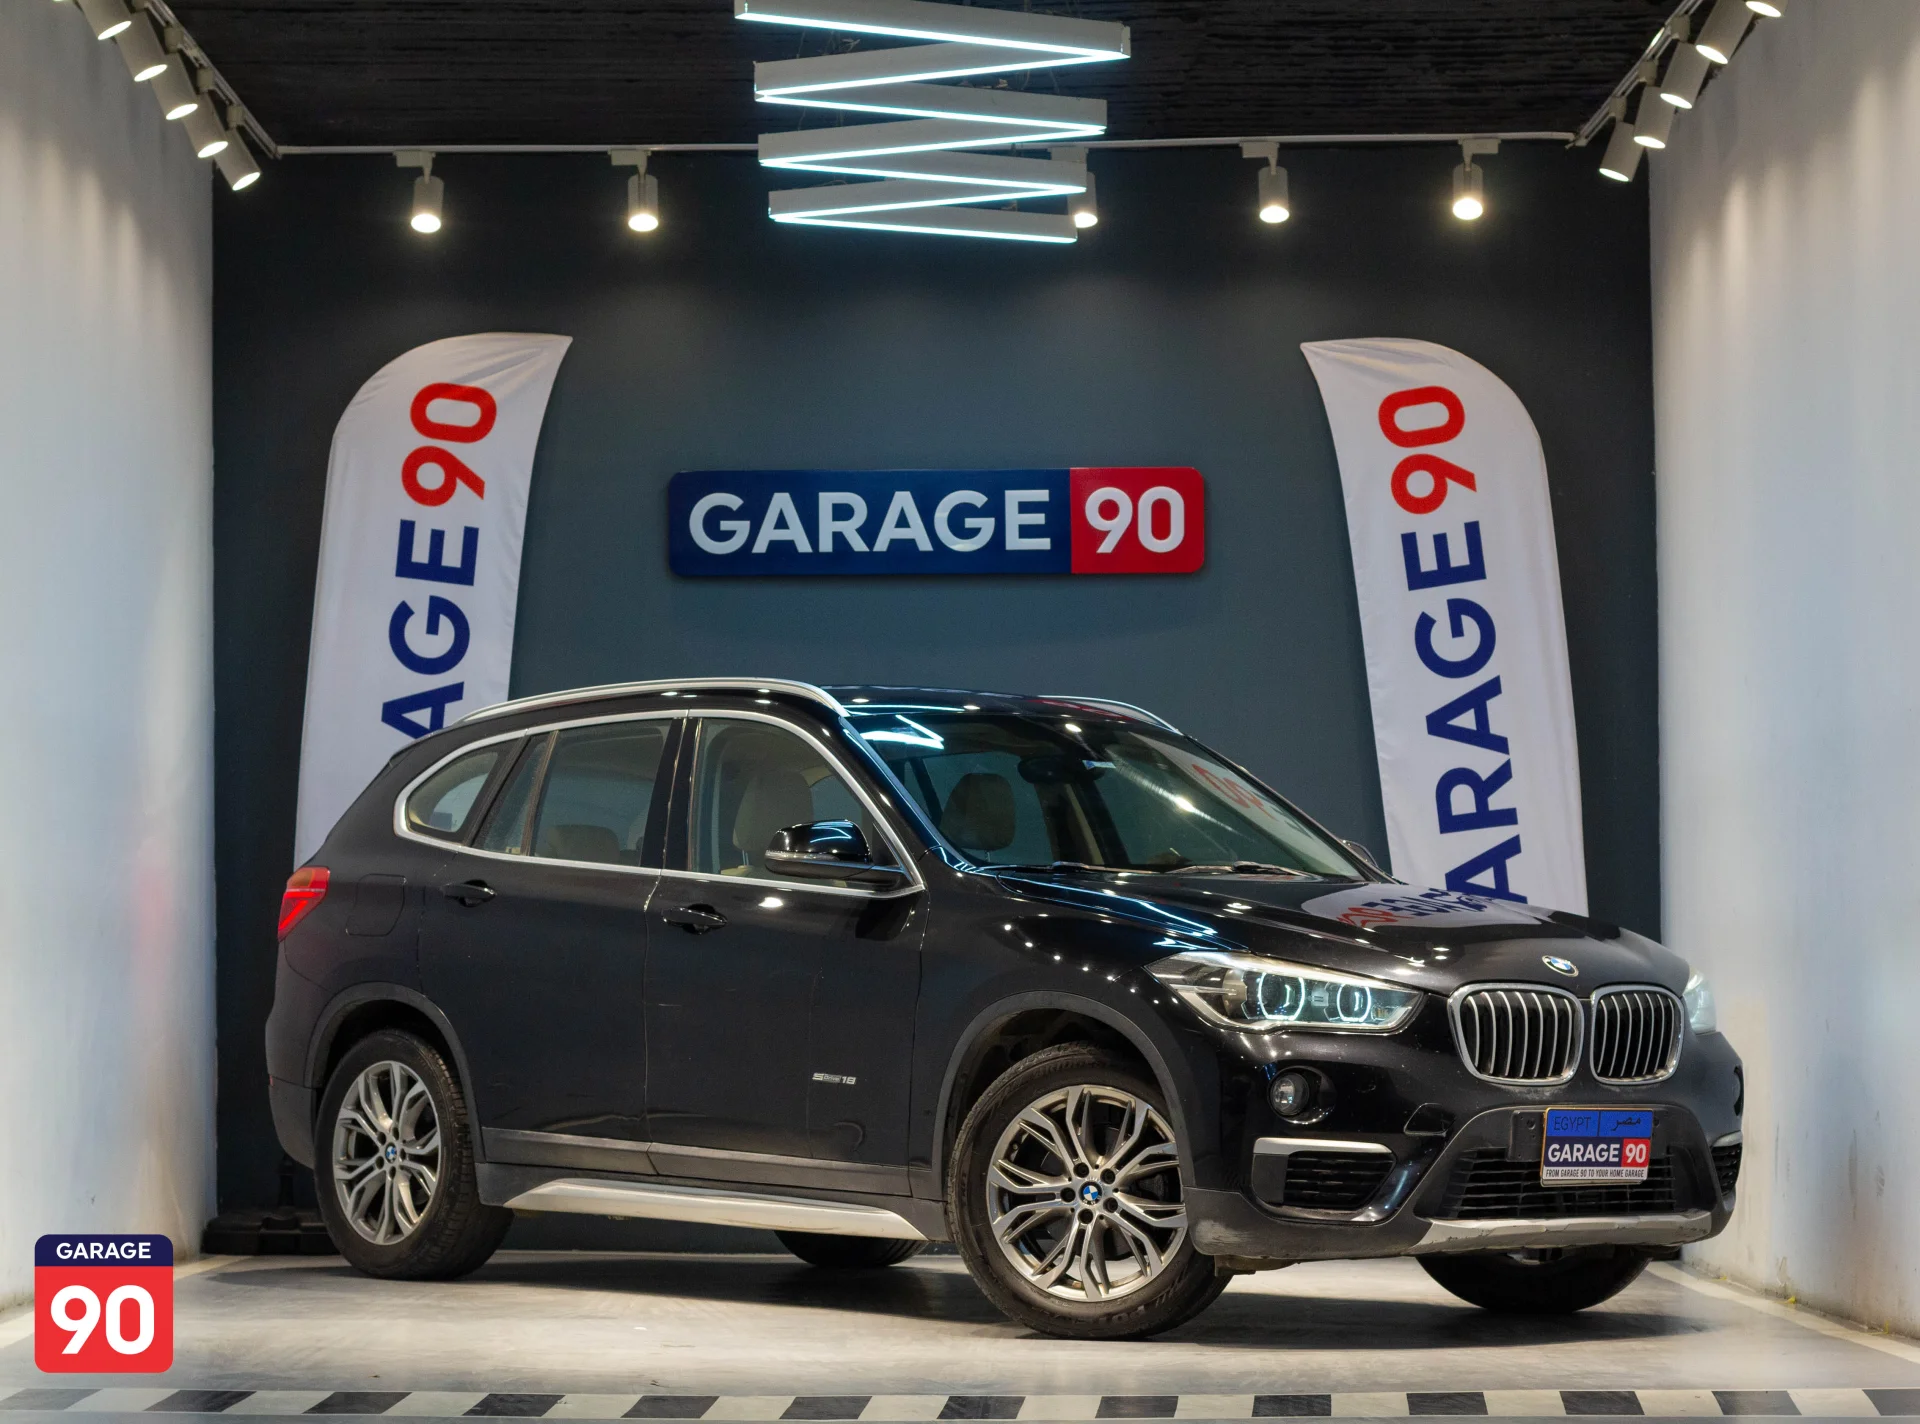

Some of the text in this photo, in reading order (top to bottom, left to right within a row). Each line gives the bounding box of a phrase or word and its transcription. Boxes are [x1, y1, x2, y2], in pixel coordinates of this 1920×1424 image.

[689, 485, 1186, 555] GARAGE 90
[1553, 1116, 1592, 1131] EGYPT
[1611, 1116, 1642, 1132] مصر
[1547, 1143, 1647, 1164] GARAGE 90
[1545, 1168, 1645, 1178] FROM GARAGE 90 TO YOUR HOME GARAGE
